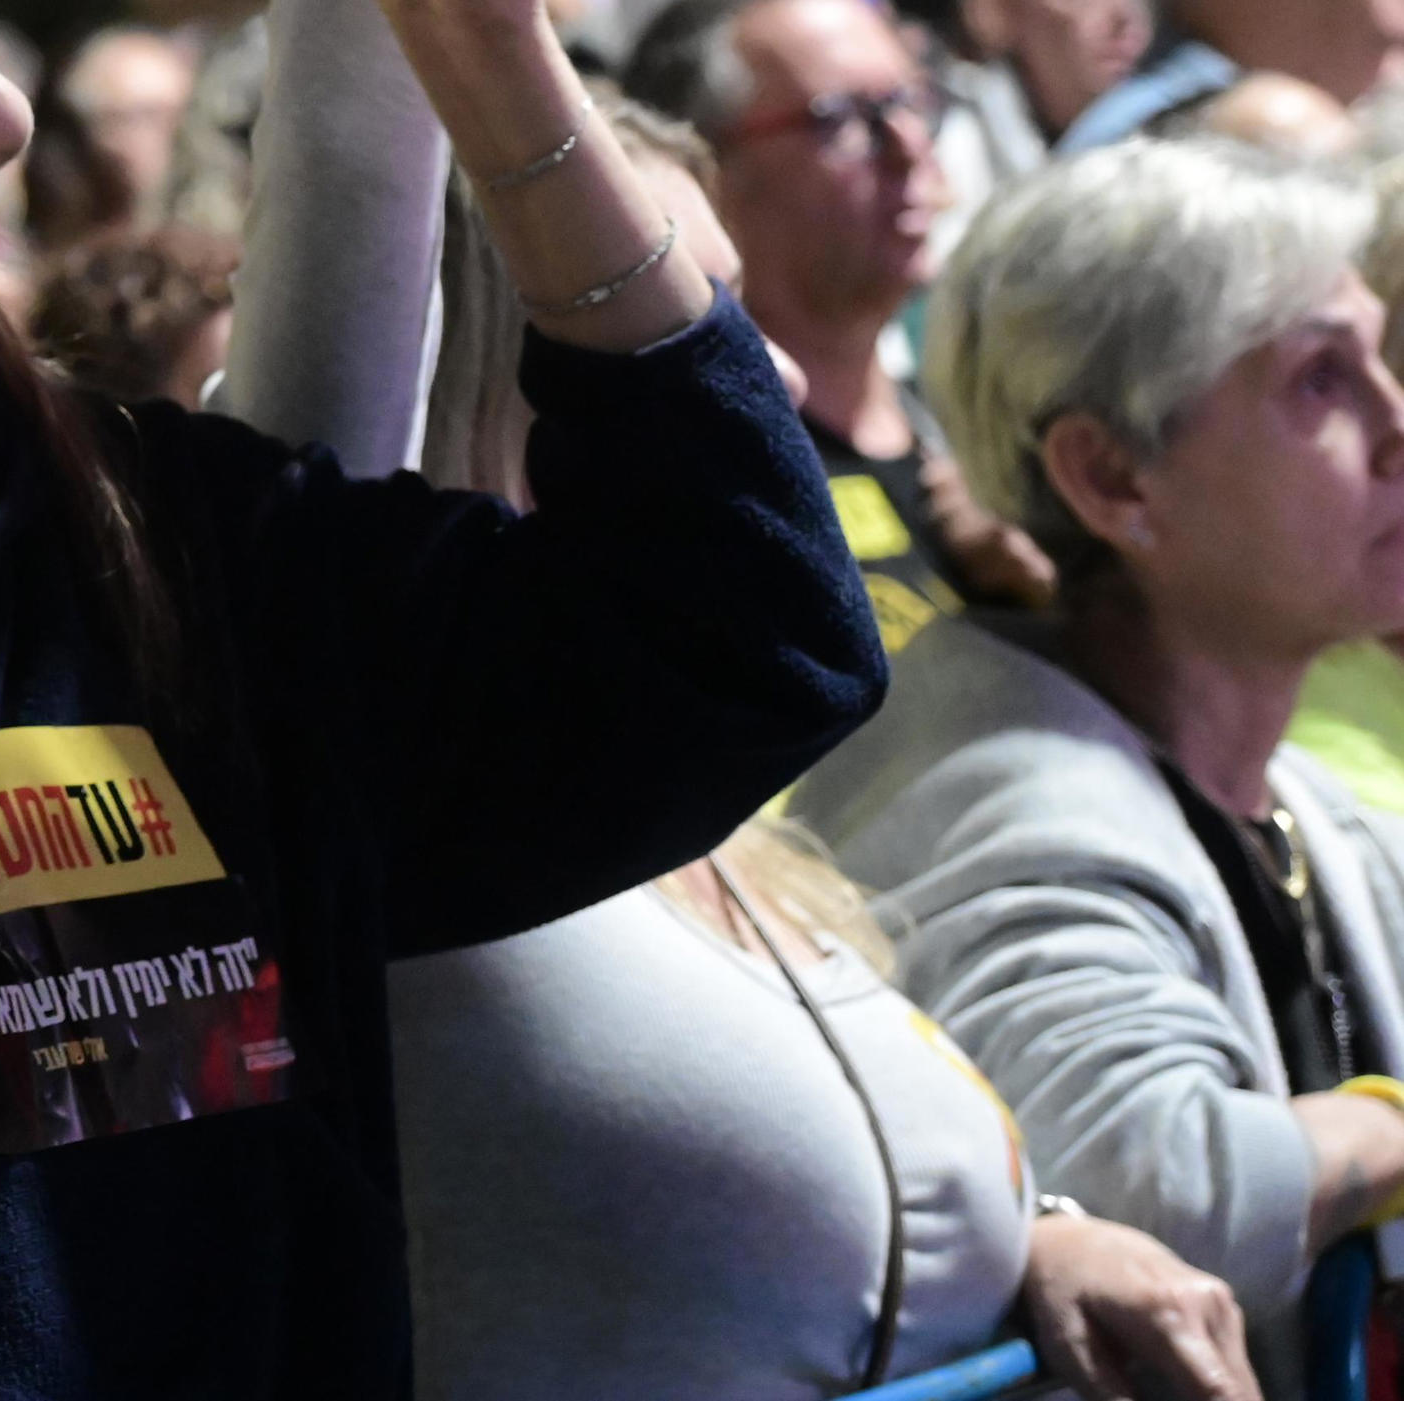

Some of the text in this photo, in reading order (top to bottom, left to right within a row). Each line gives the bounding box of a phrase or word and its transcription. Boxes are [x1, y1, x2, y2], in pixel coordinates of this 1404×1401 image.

[58, 965, 118, 1022] ולא
[111, 956, 173, 1019] ימין
[169, 945, 216, 1000] לא
